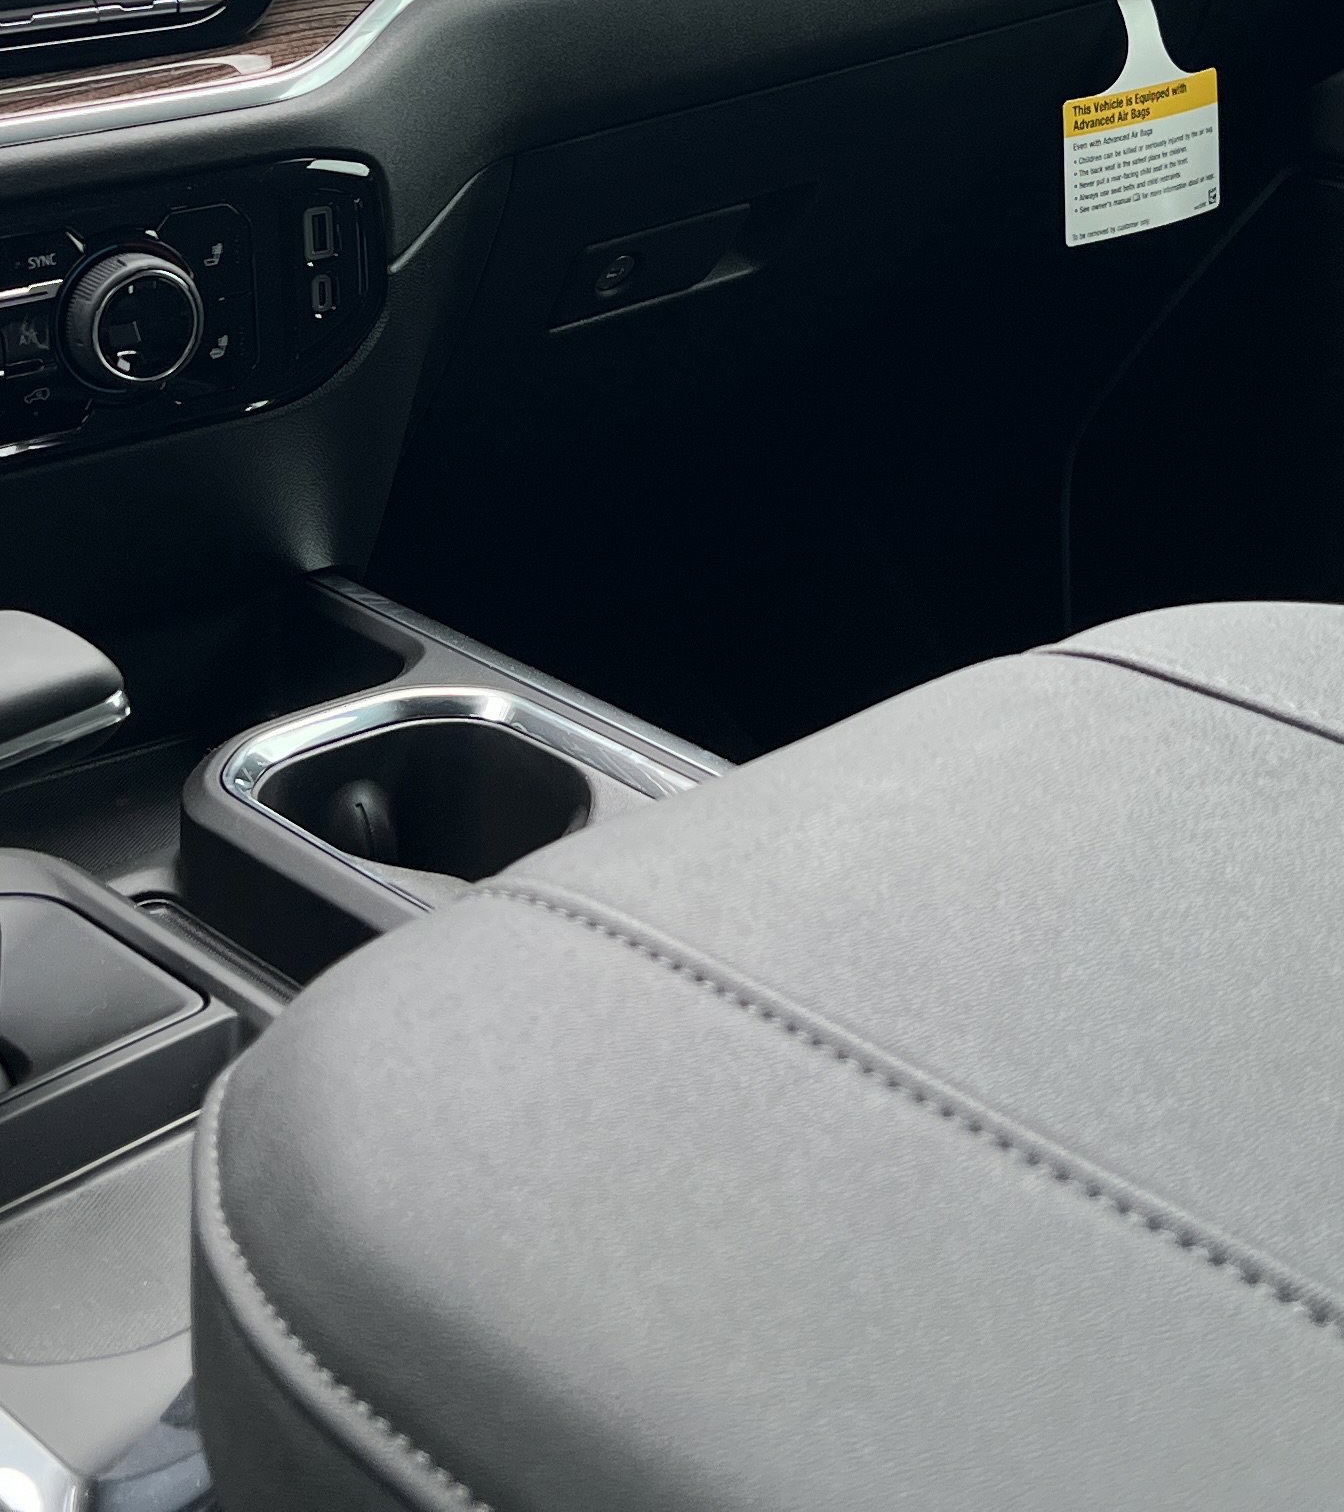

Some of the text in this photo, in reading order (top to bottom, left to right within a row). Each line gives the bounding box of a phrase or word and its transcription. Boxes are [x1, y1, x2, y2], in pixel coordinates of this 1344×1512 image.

[1072, 82, 1187, 118] This Vehicle is Equipped with
[1073, 107, 1151, 131] Advanced Air Bags
[1089, 139, 1102, 148] with
[1103, 133, 1130, 145] Advanced
[27, 252, 57, 270] SYNC
